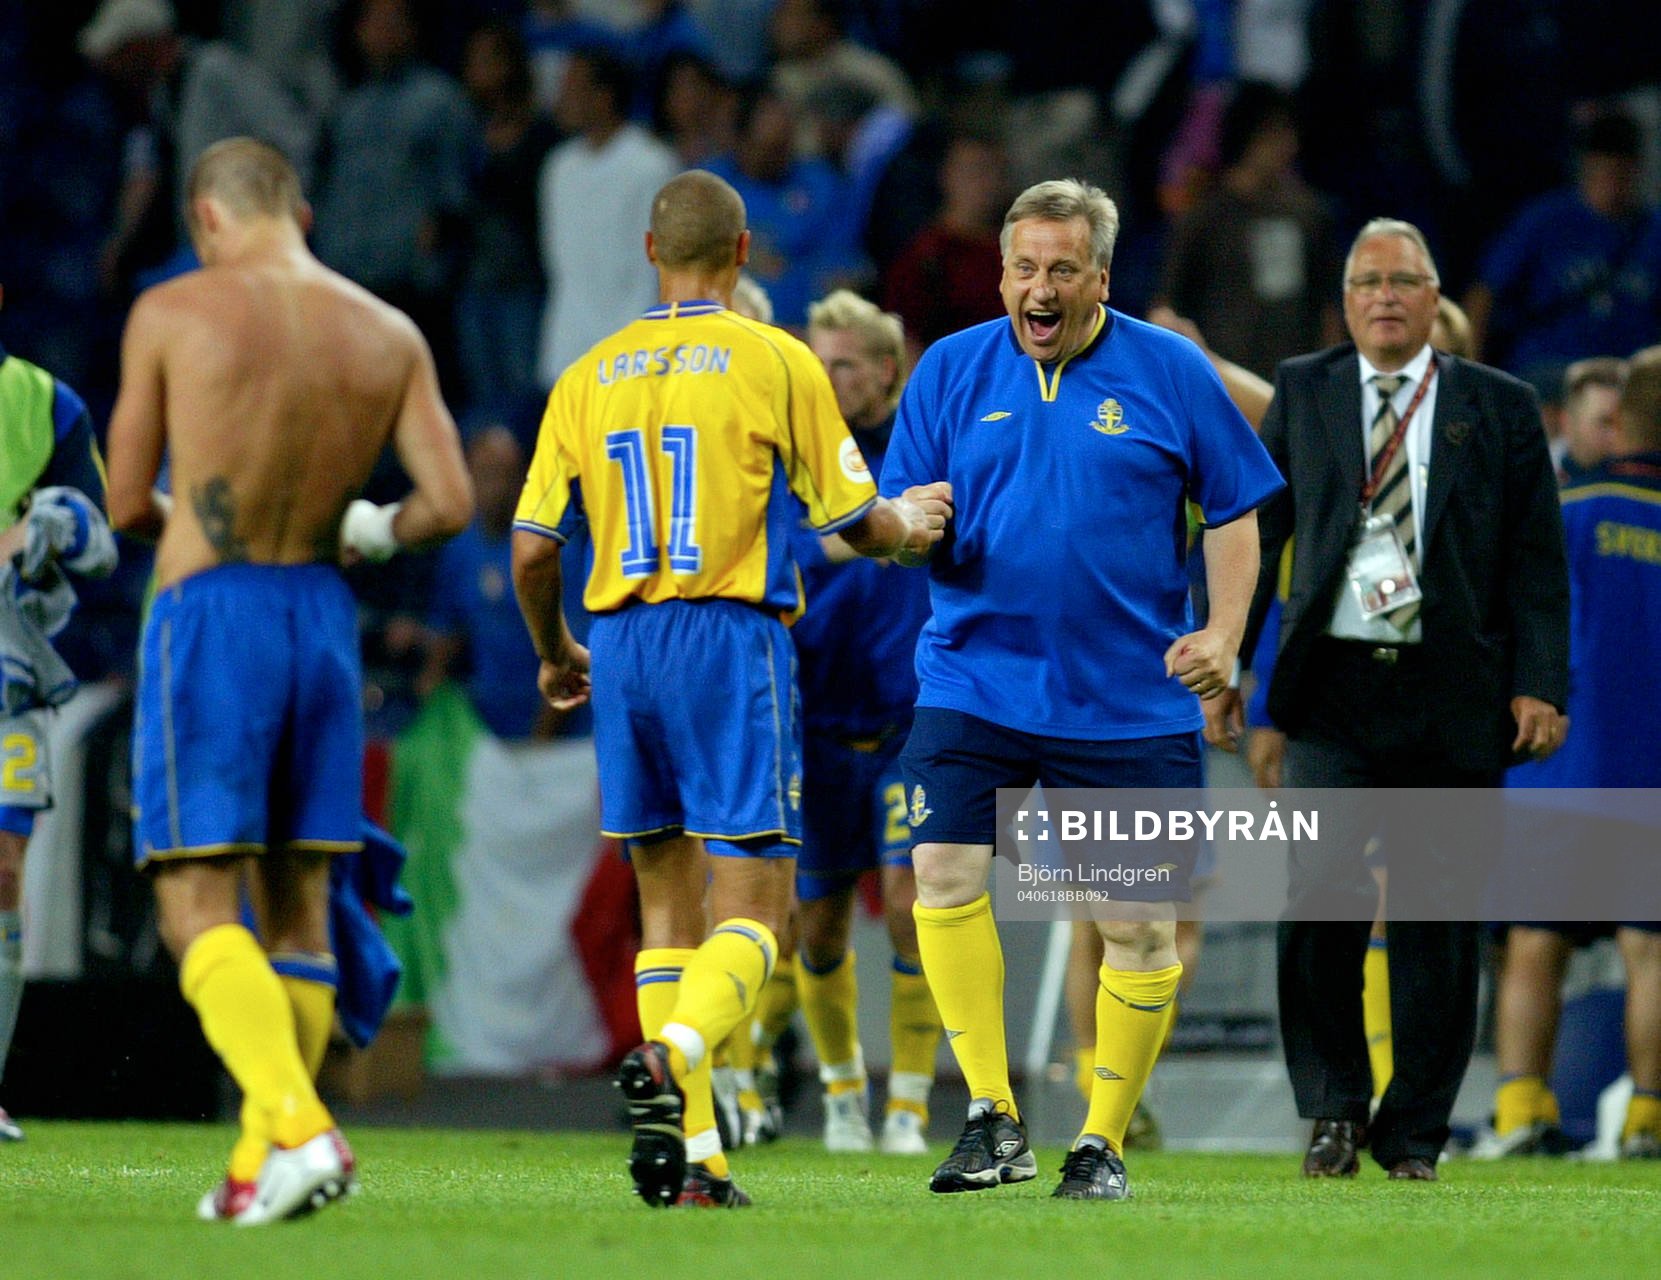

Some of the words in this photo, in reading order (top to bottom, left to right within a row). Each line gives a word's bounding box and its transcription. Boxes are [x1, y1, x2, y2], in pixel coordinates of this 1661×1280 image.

[597, 344, 731, 384] LARSSON
[606, 424, 701, 579] 11
[3, 733, 36, 792] 2
